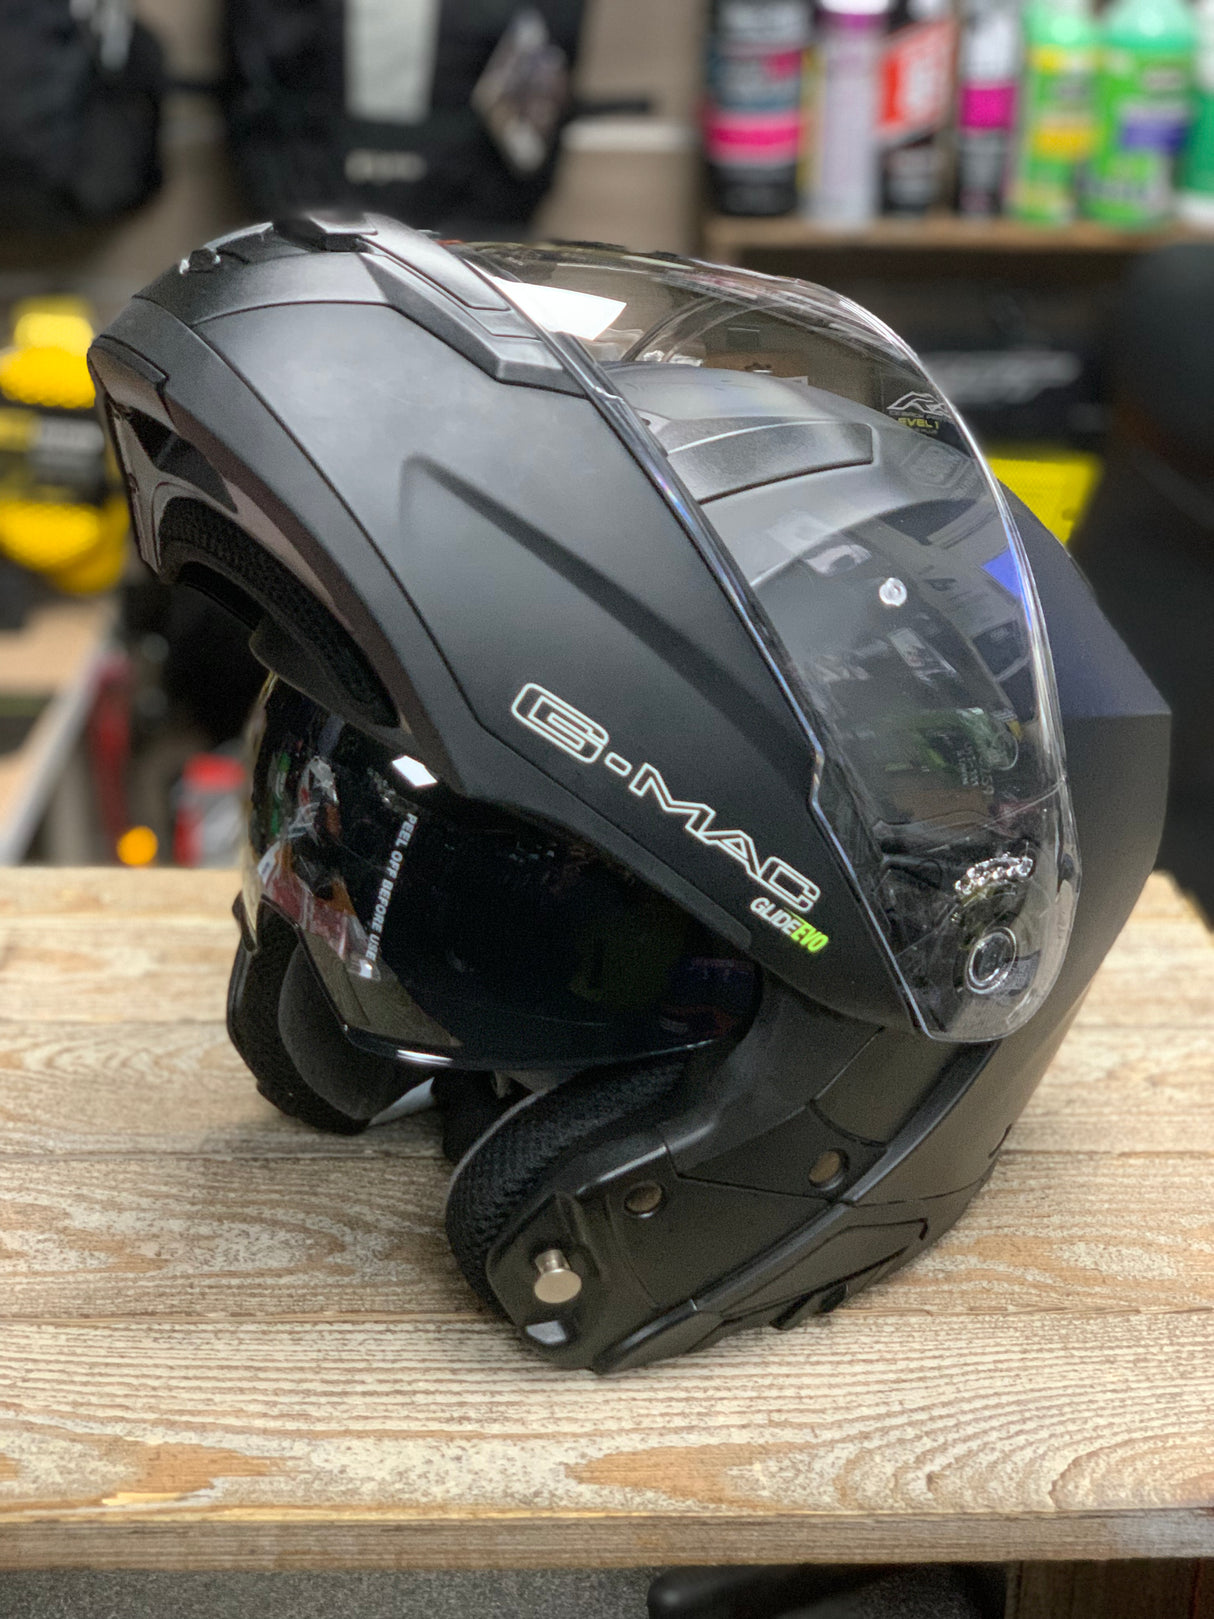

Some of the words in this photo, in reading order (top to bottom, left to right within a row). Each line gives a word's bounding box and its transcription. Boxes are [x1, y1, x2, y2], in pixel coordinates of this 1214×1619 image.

[897, 417, 934, 429] EVEL
[511, 682, 821, 912] G-MAC
[395, 813, 417, 847] PEEL
[386, 850, 402, 879] OFF
[372, 879, 393, 933] BEFORE
[365, 934, 380, 961] USE
